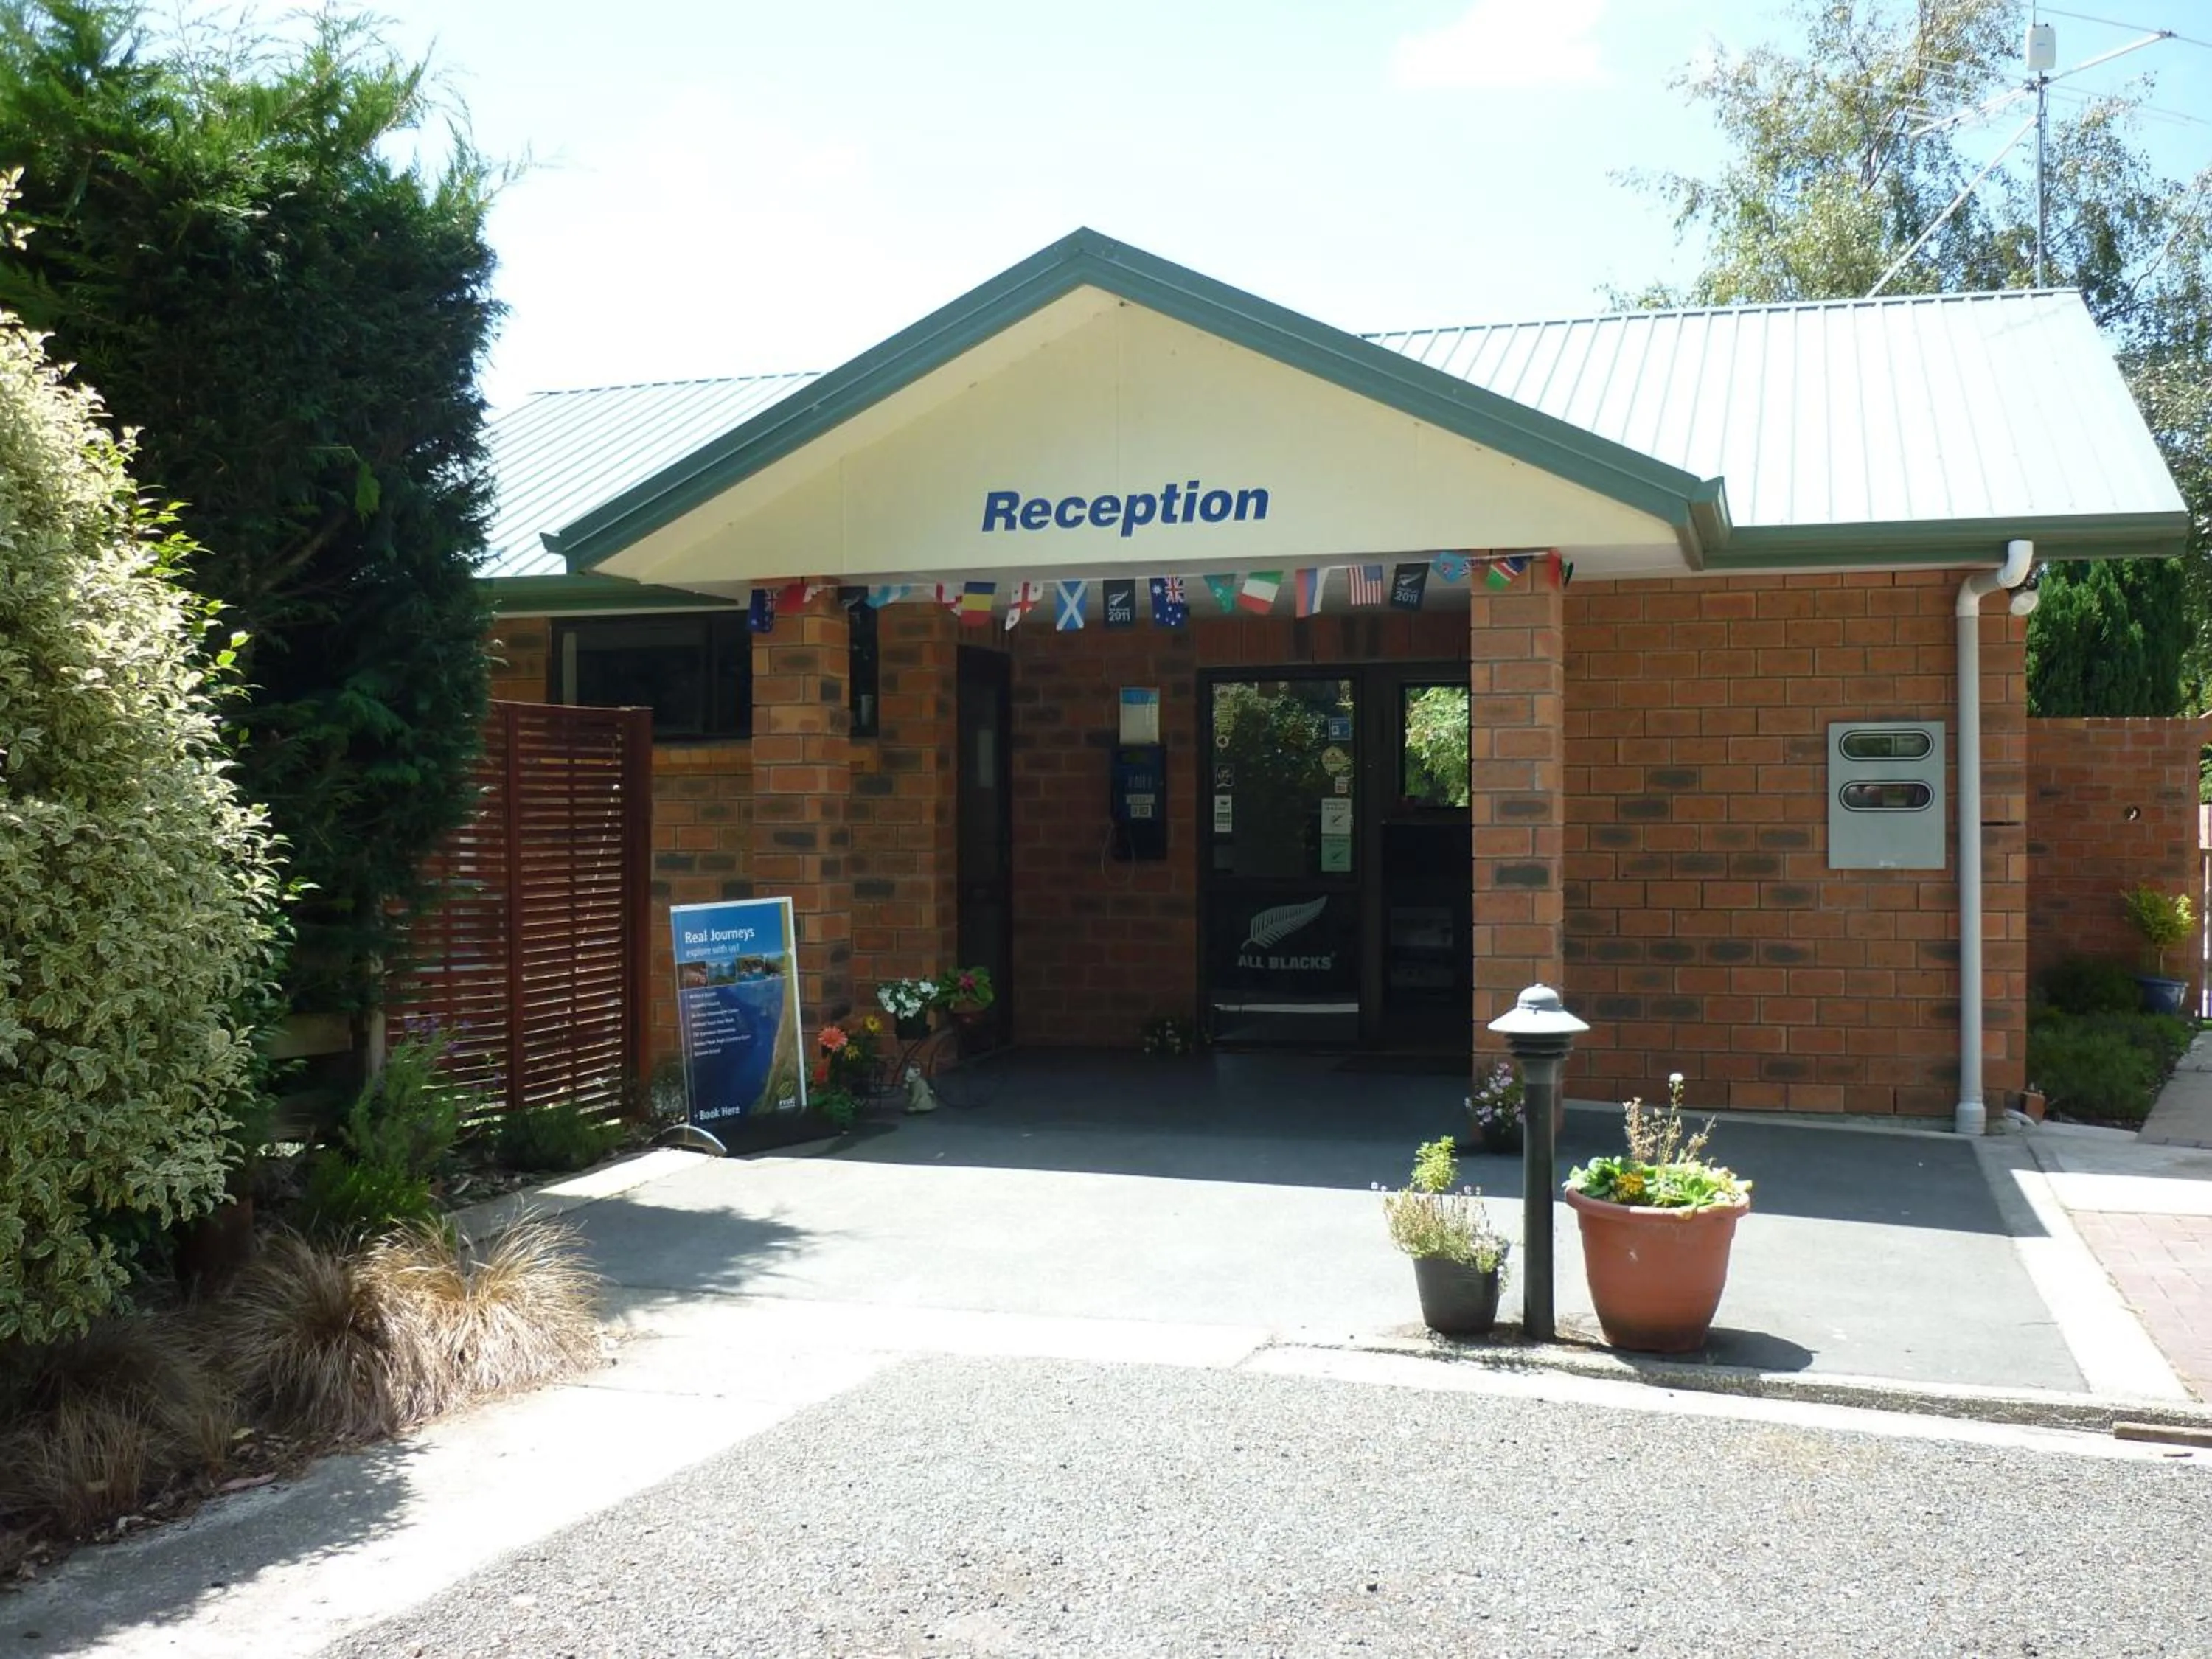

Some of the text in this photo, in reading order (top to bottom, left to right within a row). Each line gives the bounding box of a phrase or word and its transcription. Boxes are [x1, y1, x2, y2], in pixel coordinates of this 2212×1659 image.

[981, 480, 1270, 538] Reception
[1394, 591, 1418, 603] 2011
[1108, 611, 1130, 622] 2011
[684, 928, 755, 945] Real Journeys
[1237, 955, 1332, 970] ALL BLACKS
[699, 1105, 741, 1120] Book Here
